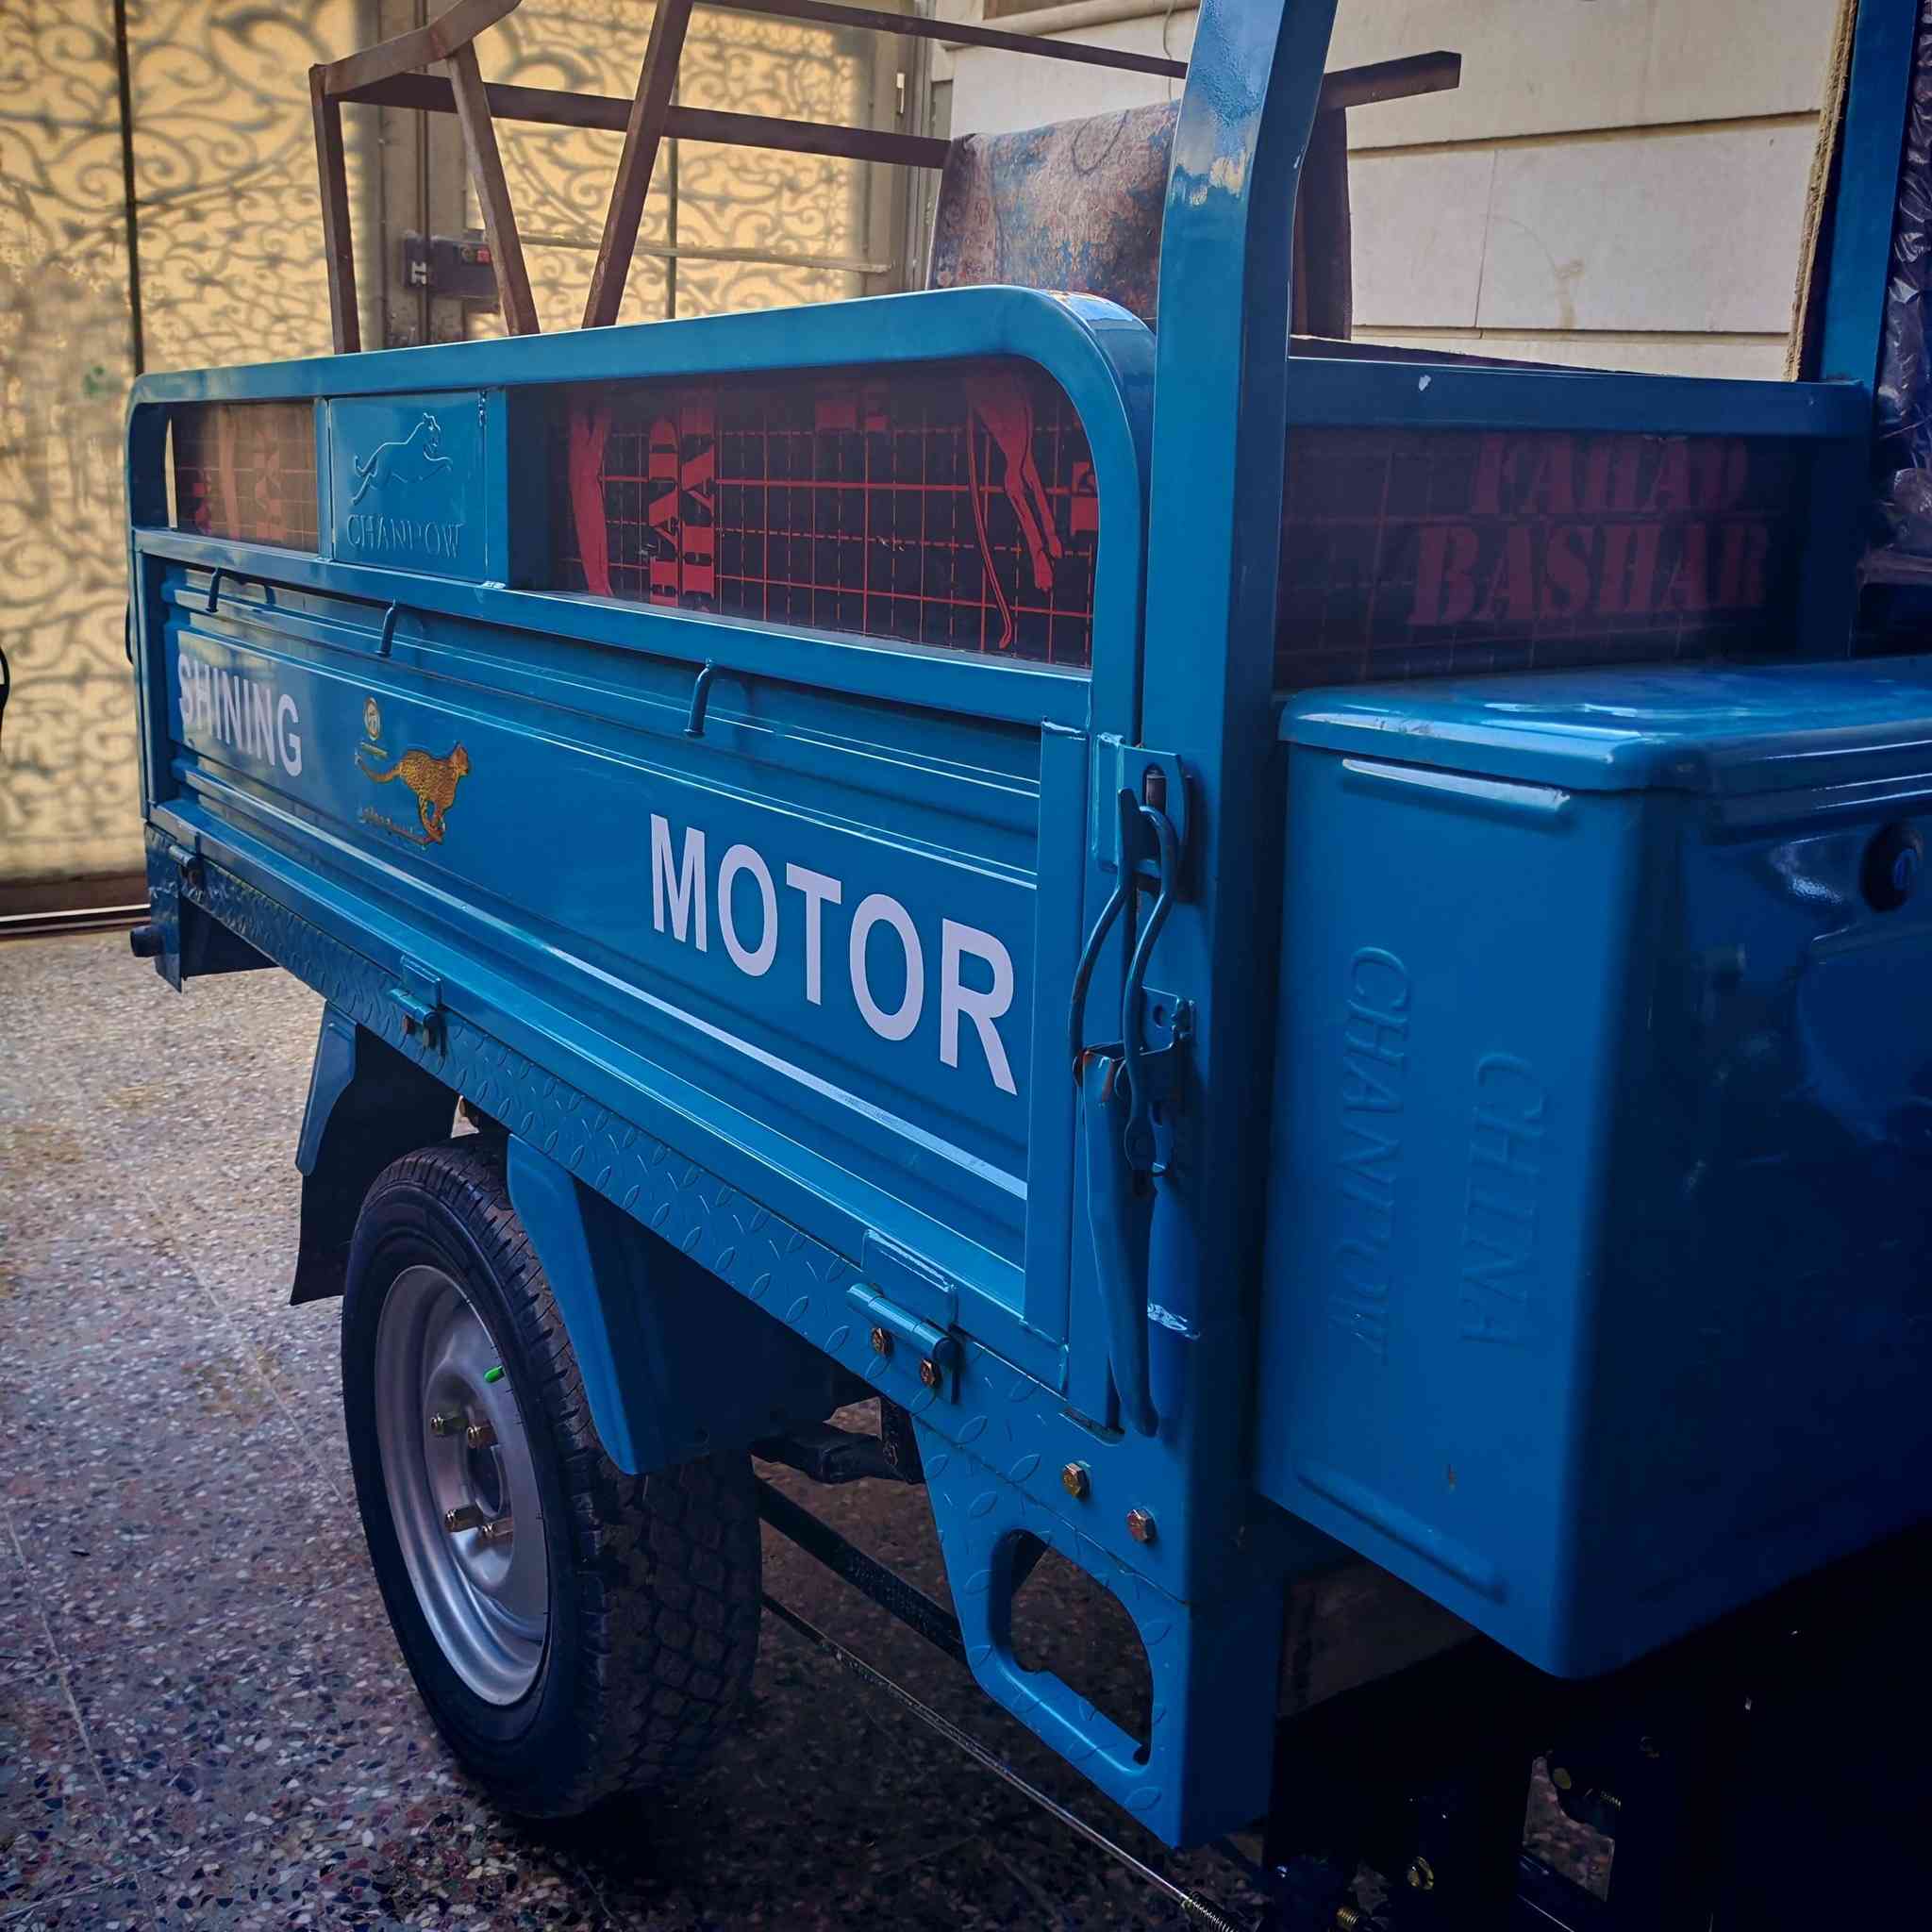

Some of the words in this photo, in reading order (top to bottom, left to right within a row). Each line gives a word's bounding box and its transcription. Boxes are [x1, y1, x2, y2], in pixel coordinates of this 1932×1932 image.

[1406, 522, 1771, 625] BASHAR
[177, 653, 302, 777] SHINING
[650, 813, 1017, 1095] MOTOR
